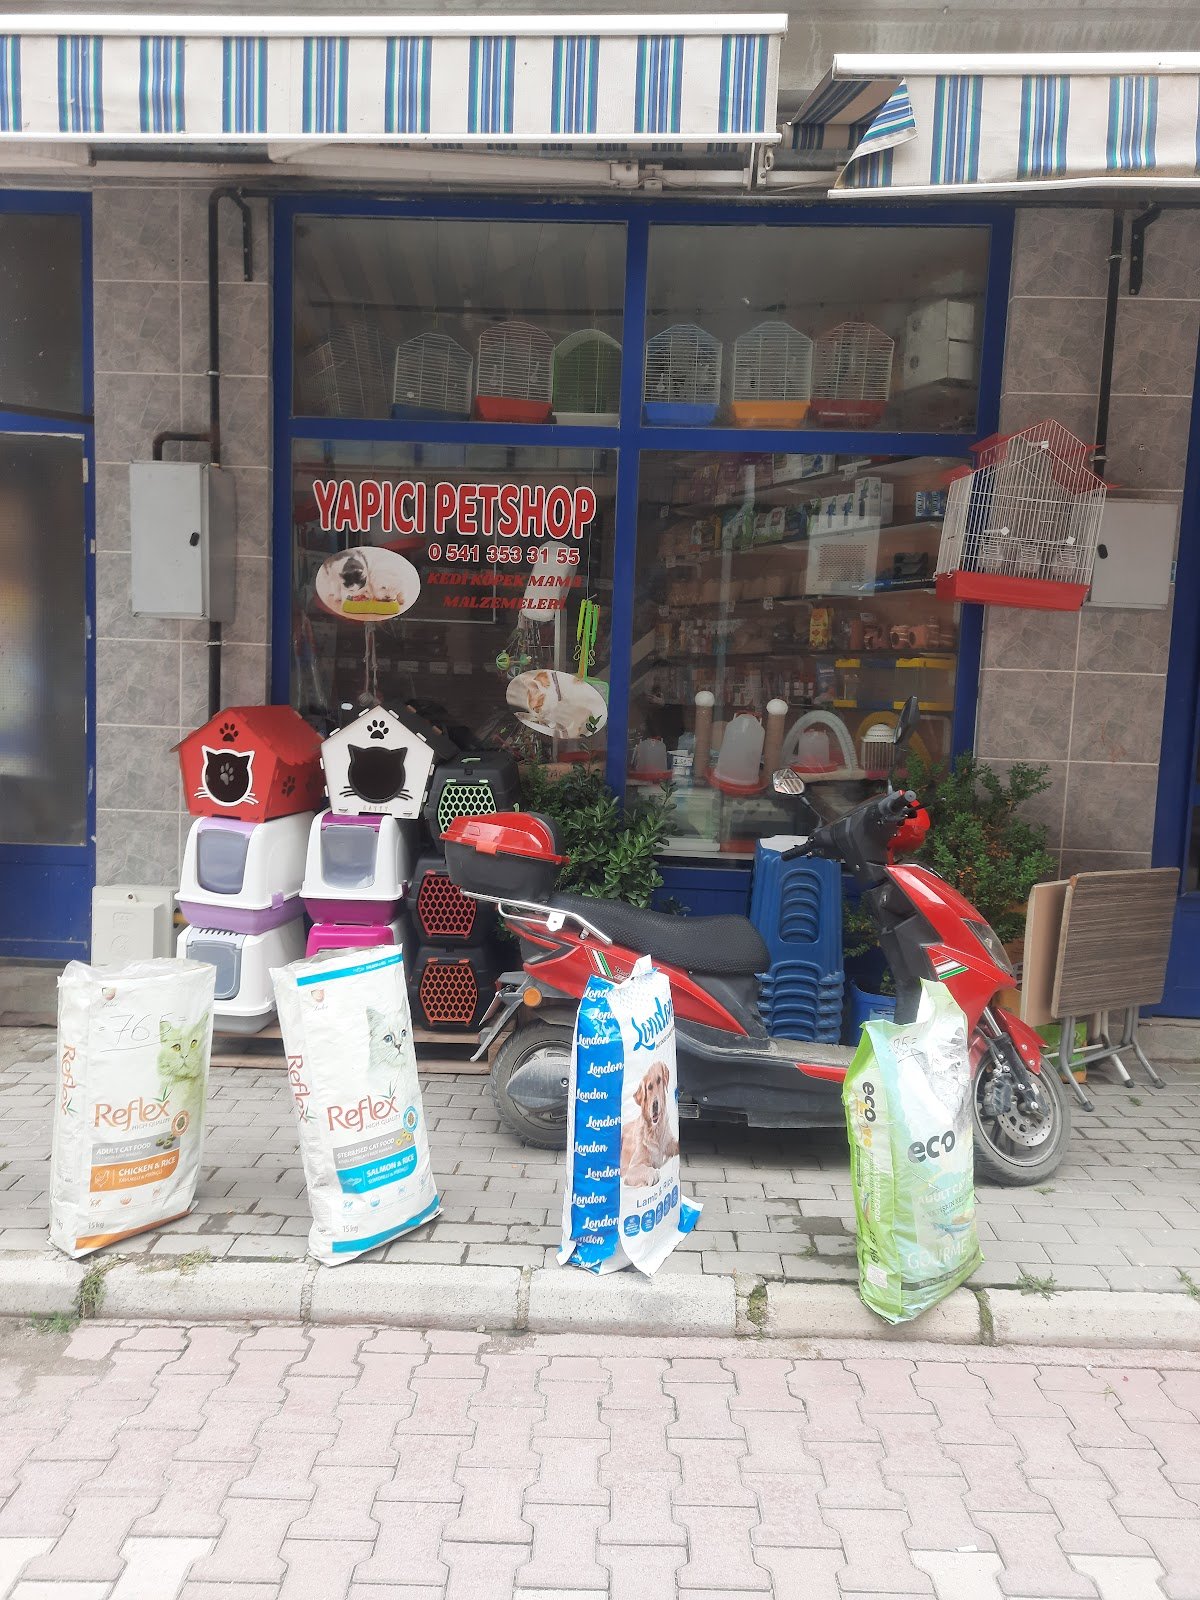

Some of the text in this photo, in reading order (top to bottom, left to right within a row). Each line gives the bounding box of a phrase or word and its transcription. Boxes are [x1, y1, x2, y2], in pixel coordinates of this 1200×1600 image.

[313, 480, 597, 539] YAPICI PETSHOP
[428, 543, 581, 565] 0 541 353 31 55
[427, 571, 467, 585] KEDİ
[528, 575, 584, 588] MAMA
[443, 594, 567, 610] MALZEMELERİ
[577, 1033, 611, 1049] London
[587, 1061, 624, 1078] London
[288, 1054, 311, 1124] Reflex
[576, 1088, 609, 1103] London
[862, 1081, 877, 1122] eco
[93, 1096, 170, 1132] Reflex
[326, 1094, 399, 1132] Reflex
[585, 1115, 622, 1131] London
[96, 1146, 119, 1155] ADULT
[119, 1144, 132, 1153] CAT
[133, 1142, 152, 1151] FOOD
[368, 1142, 380, 1151] CAT
[380, 1137, 395, 1147] FOOD
[573, 1141, 609, 1156] London
[907, 1130, 956, 1164] eco
[118, 1164, 154, 1176] CHICKEN
[161, 1155, 176, 1167] RICE
[366, 1160, 396, 1177] SALMON
[402, 1154, 415, 1166] RICE
[584, 1166, 620, 1181] London
[572, 1192, 607, 1208] London
[342, 1224, 359, 1233] 15kg
[582, 1215, 619, 1231] London
